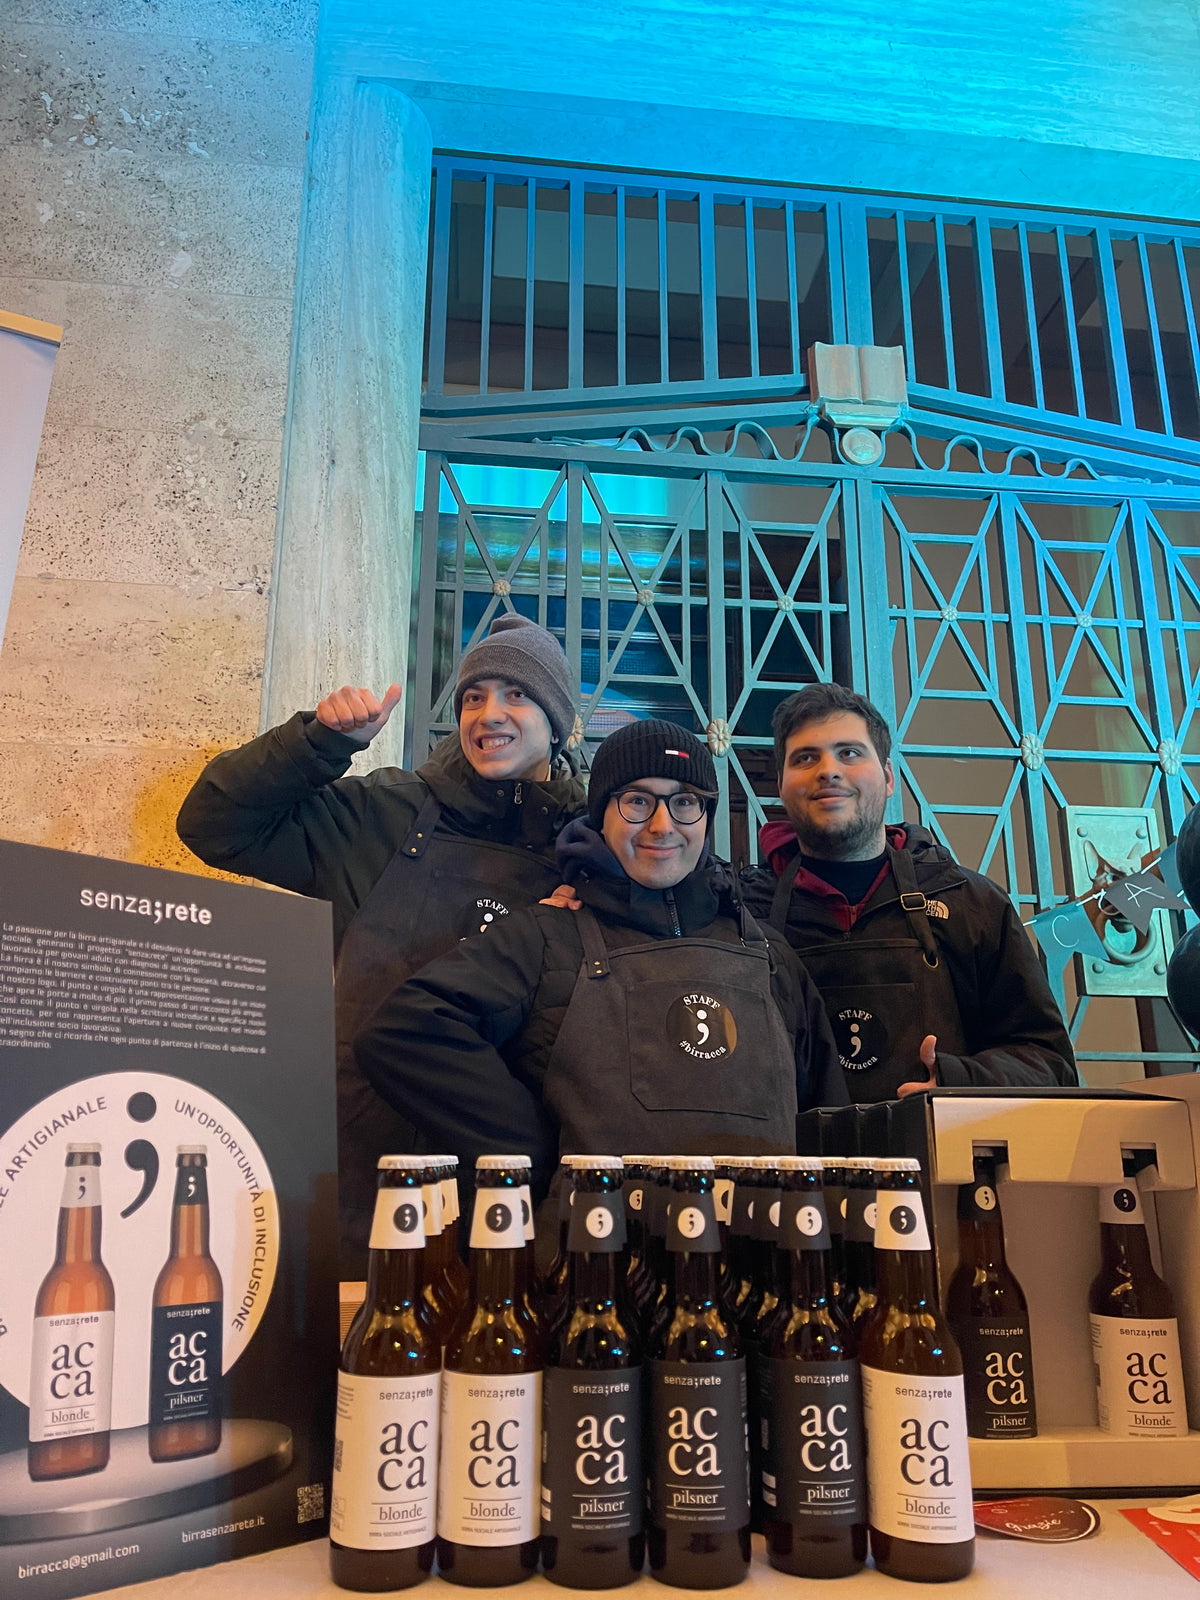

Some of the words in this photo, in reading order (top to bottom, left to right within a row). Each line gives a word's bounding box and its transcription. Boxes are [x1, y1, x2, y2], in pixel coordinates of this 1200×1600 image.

[80, 890, 212, 924] senza;rete
[476, 899, 508, 914] STAFF
[683, 994, 720, 1009] STAFF
[838, 1010, 872, 1020] STAFF
[680, 1040, 726, 1059] #birracca
[6, 1096, 106, 1182] ARTIGIANALE
[174, 1100, 264, 1202] UN'OPPORTUNITÀ
[254, 1206, 266, 1222] DI
[232, 1228, 266, 1332] INCLUSIONE
[52, 1342, 94, 1371] ac
[169, 1331, 207, 1360] ac
[168, 1358, 208, 1386] ca
[986, 1352, 1024, 1377] ac
[1127, 1352, 1167, 1377] ac
[50, 1370, 94, 1399] ca
[573, 1383, 630, 1397] senza;rete
[664, 1375, 721, 1389] senza;rete
[795, 1374, 849, 1387] senza;rete
[987, 1379, 1028, 1405] ca
[1128, 1379, 1172, 1404] ca
[170, 1393, 203, 1408] pilsner
[379, 1387, 433, 1402] senza;rete
[468, 1388, 525, 1400] senza;rete
[895, 1387, 952, 1400] senza;rete
[52, 1408, 90, 1423] blonde
[668, 1407, 718, 1440] ac
[800, 1404, 848, 1437] ac
[993, 1415, 1026, 1429] pilsner
[1134, 1414, 1171, 1426] blonde
[379, 1420, 428, 1455] ac
[469, 1420, 520, 1452] ac
[576, 1414, 626, 1449] ac
[900, 1418, 950, 1452] ac
[576, 1450, 628, 1485] ca
[668, 1442, 722, 1476] ca
[801, 1439, 852, 1472] ca
[378, 1456, 427, 1491] ca
[468, 1455, 520, 1488] ca
[901, 1454, 953, 1487] ca
[673, 1490, 718, 1506] pilsner
[807, 1486, 850, 1502] pilsner
[379, 1504, 422, 1521] blonde
[470, 1503, 515, 1517] blonde
[580, 1499, 624, 1516] pilsner
[906, 1499, 950, 1515] blonde
[182, 1516, 265, 1543] birrasenzarete.it
[18, 1542, 140, 1579] birracca@gmail.com
